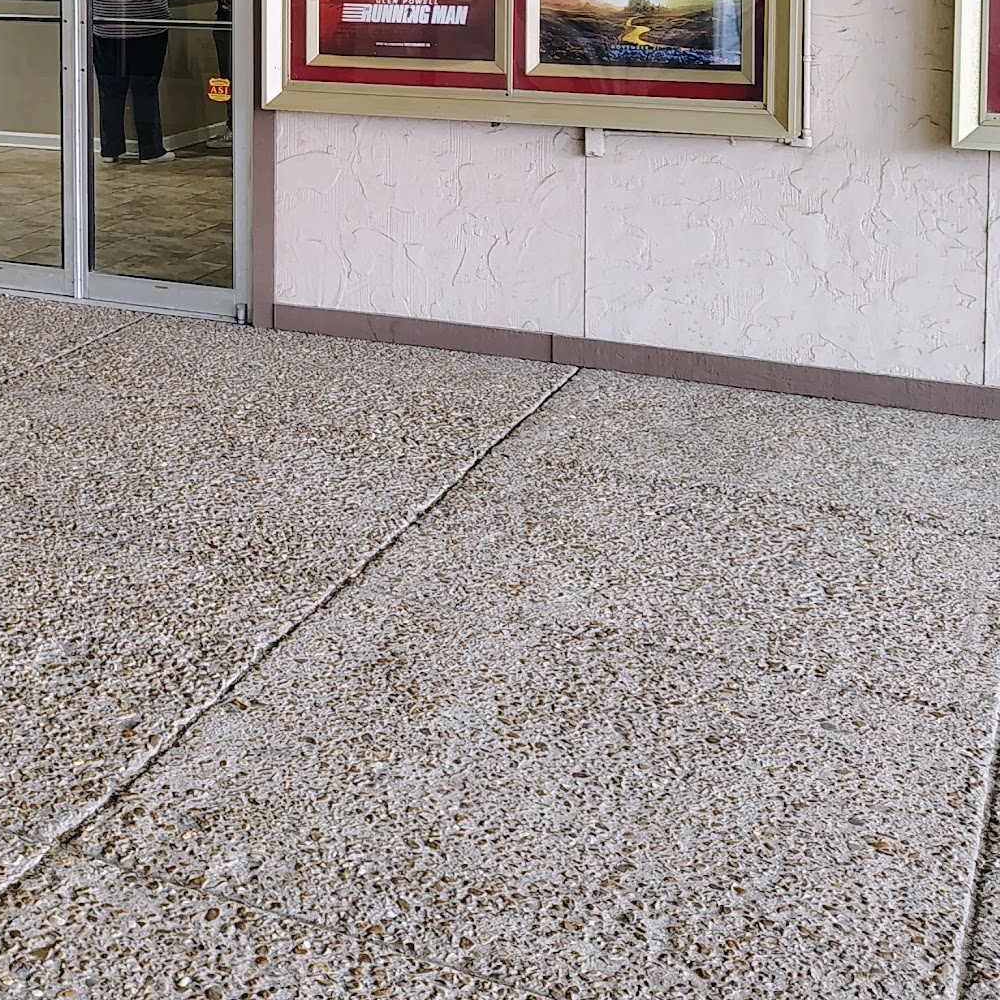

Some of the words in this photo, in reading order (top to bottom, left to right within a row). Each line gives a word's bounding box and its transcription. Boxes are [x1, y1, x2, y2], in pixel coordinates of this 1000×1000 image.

[341, 3, 431, 25] RUNNING
[431, 5, 469, 26] MAN
[210, 86, 228, 95] ASI
